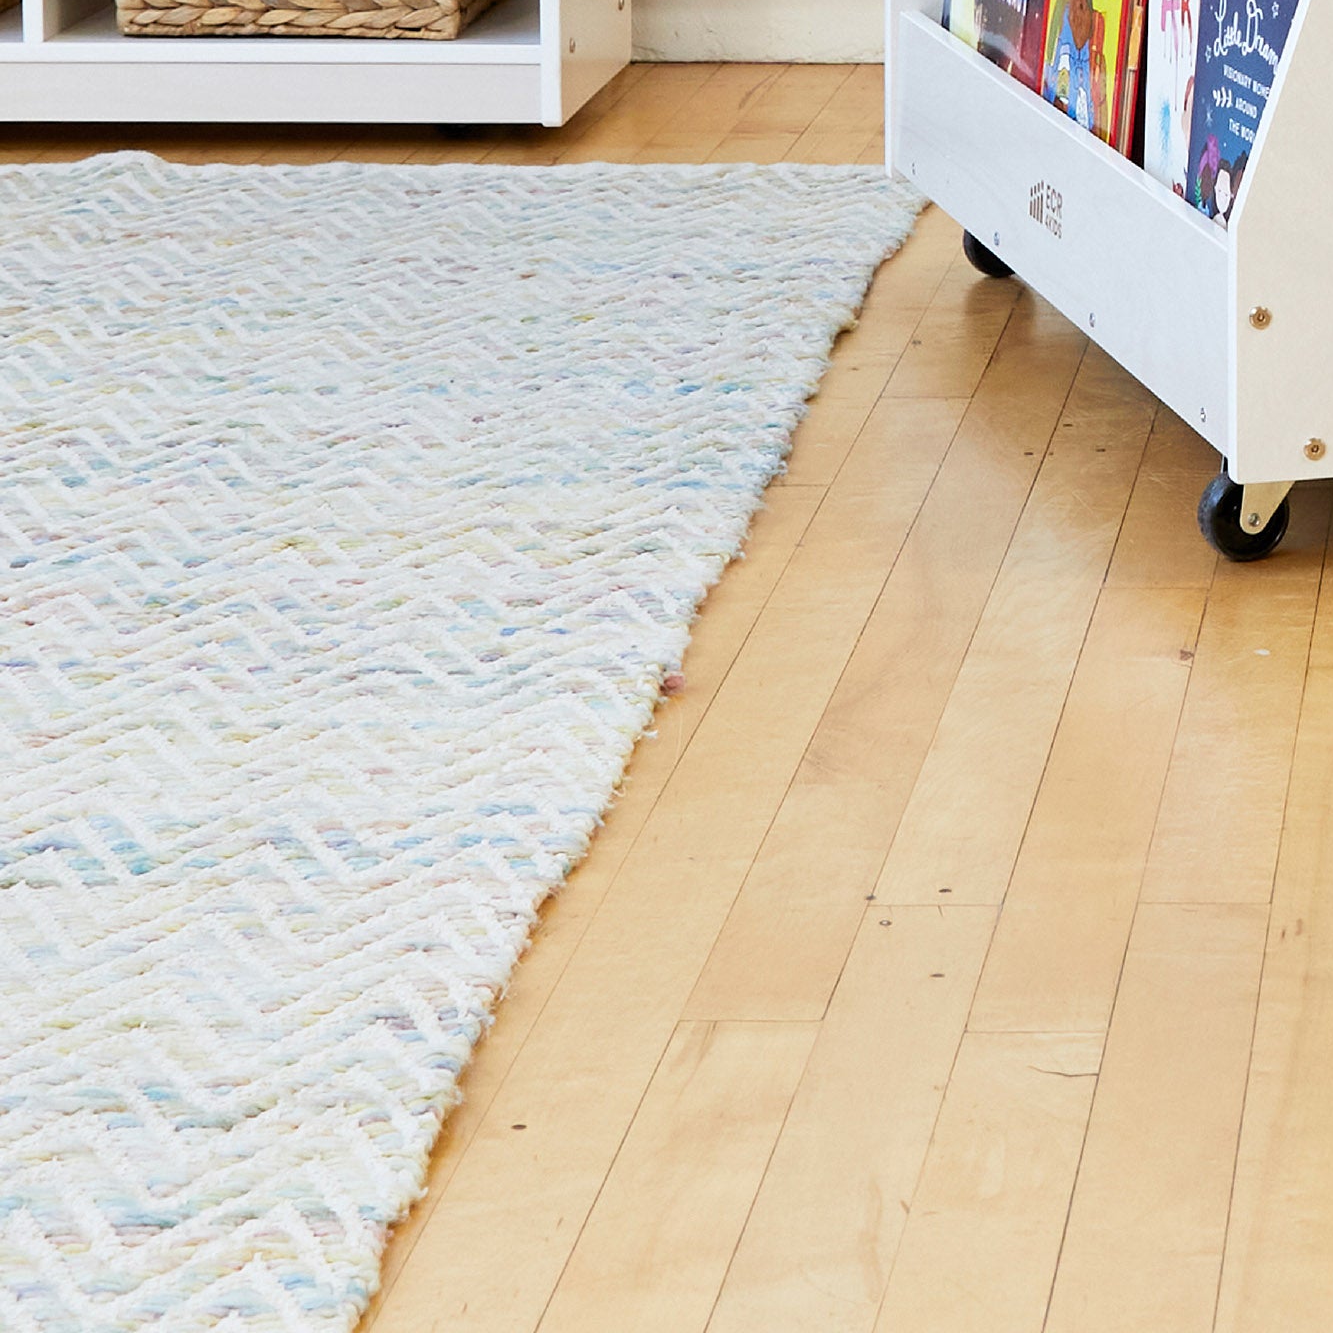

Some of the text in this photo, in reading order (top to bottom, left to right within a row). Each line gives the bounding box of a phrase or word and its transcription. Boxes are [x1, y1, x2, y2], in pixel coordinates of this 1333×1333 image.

[1223, 64, 1270, 100] VISIONARY WOME
[1235, 96, 1257, 119] AROUND
[1229, 118, 1255, 143] THE WOR
